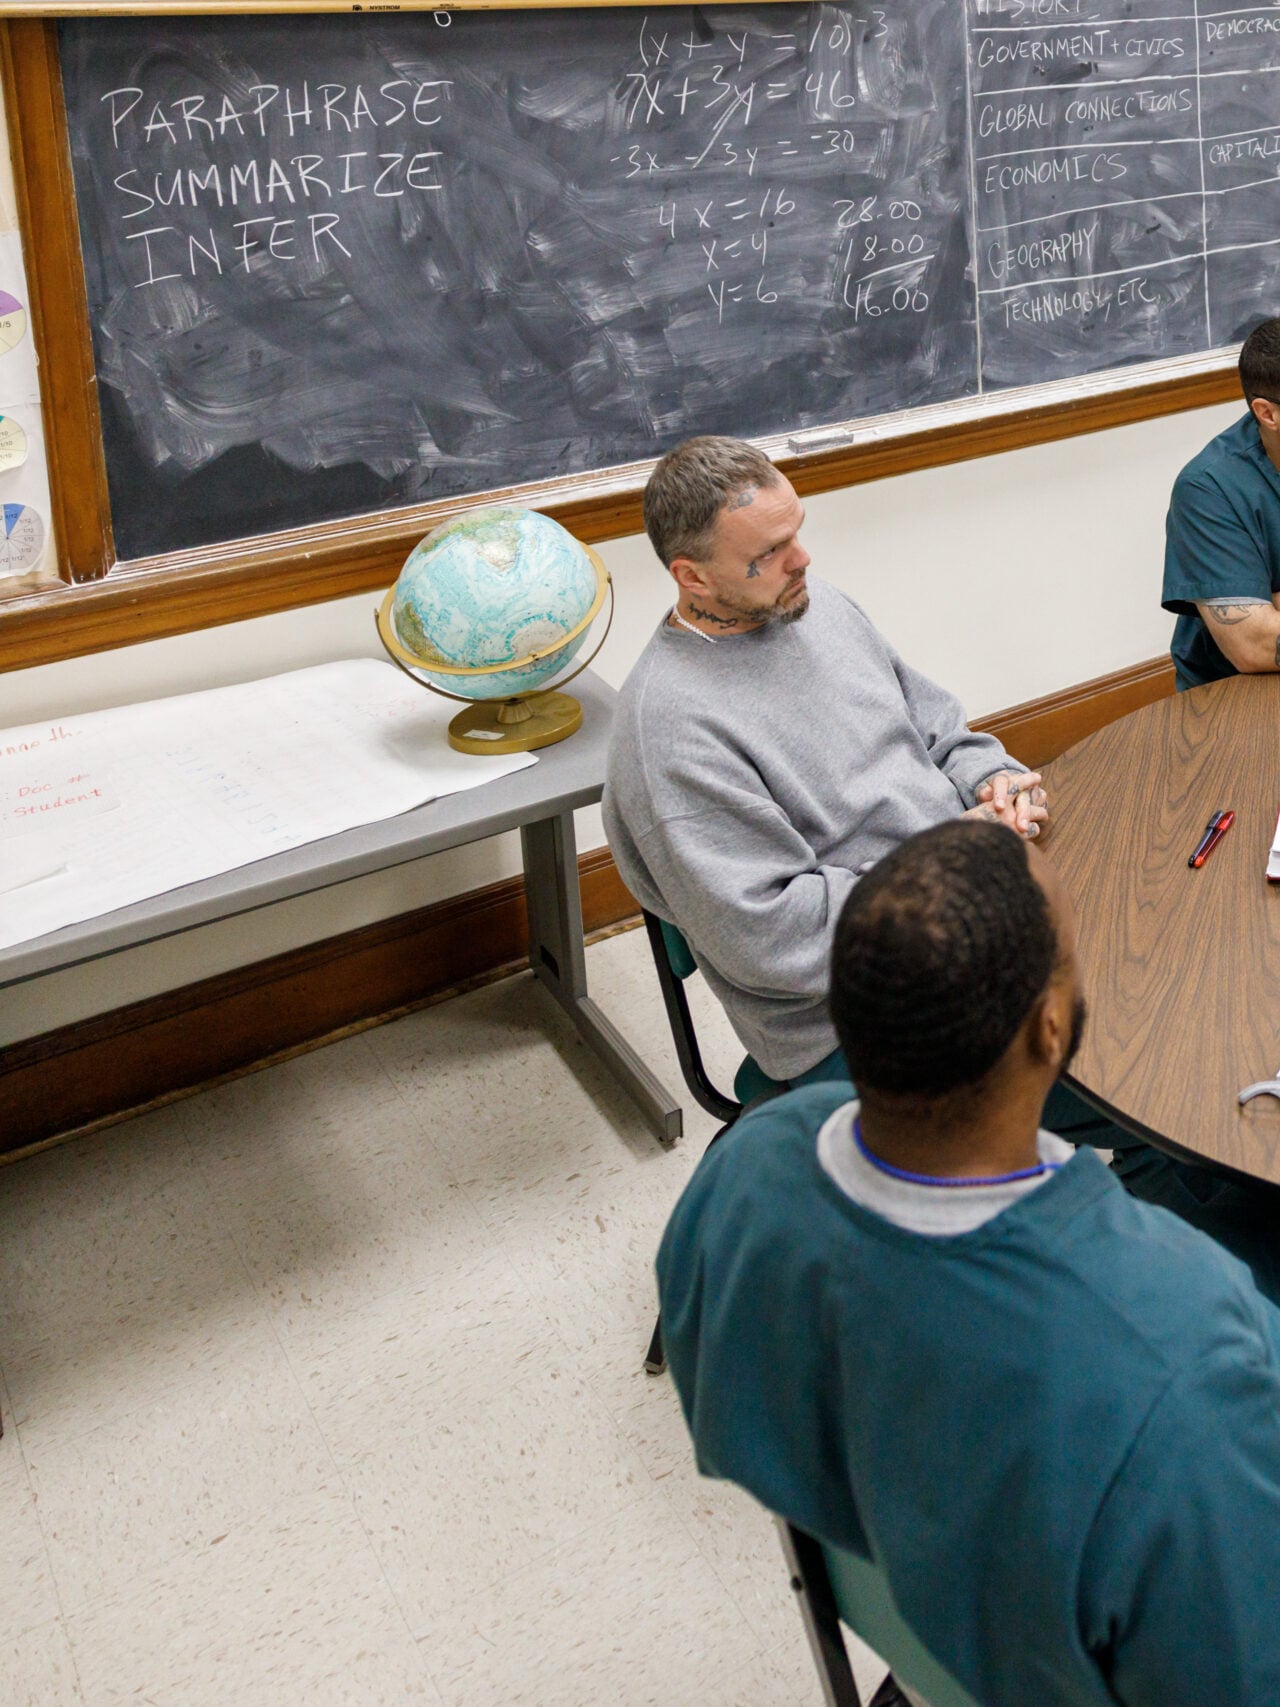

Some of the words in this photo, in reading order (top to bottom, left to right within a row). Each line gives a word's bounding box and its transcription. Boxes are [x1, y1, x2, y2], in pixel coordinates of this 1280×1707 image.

[978, 30, 1110, 68] GOVERNMENT
[1125, 38, 1184, 58] CIVICS
[805, 70, 855, 110] 46
[979, 103, 1049, 137] GLOBAL
[1065, 89, 1192, 124] CONNECTIONS
[101, 80, 454, 149] PARAPHRASE
[114, 152, 444, 218] SUMMARIZE
[985, 153, 1127, 193] ECONOMICS
[125, 213, 352, 288] INFER
[988, 222, 1098, 279] GEOGRAPHY
[13, 788, 103, 818] Student
